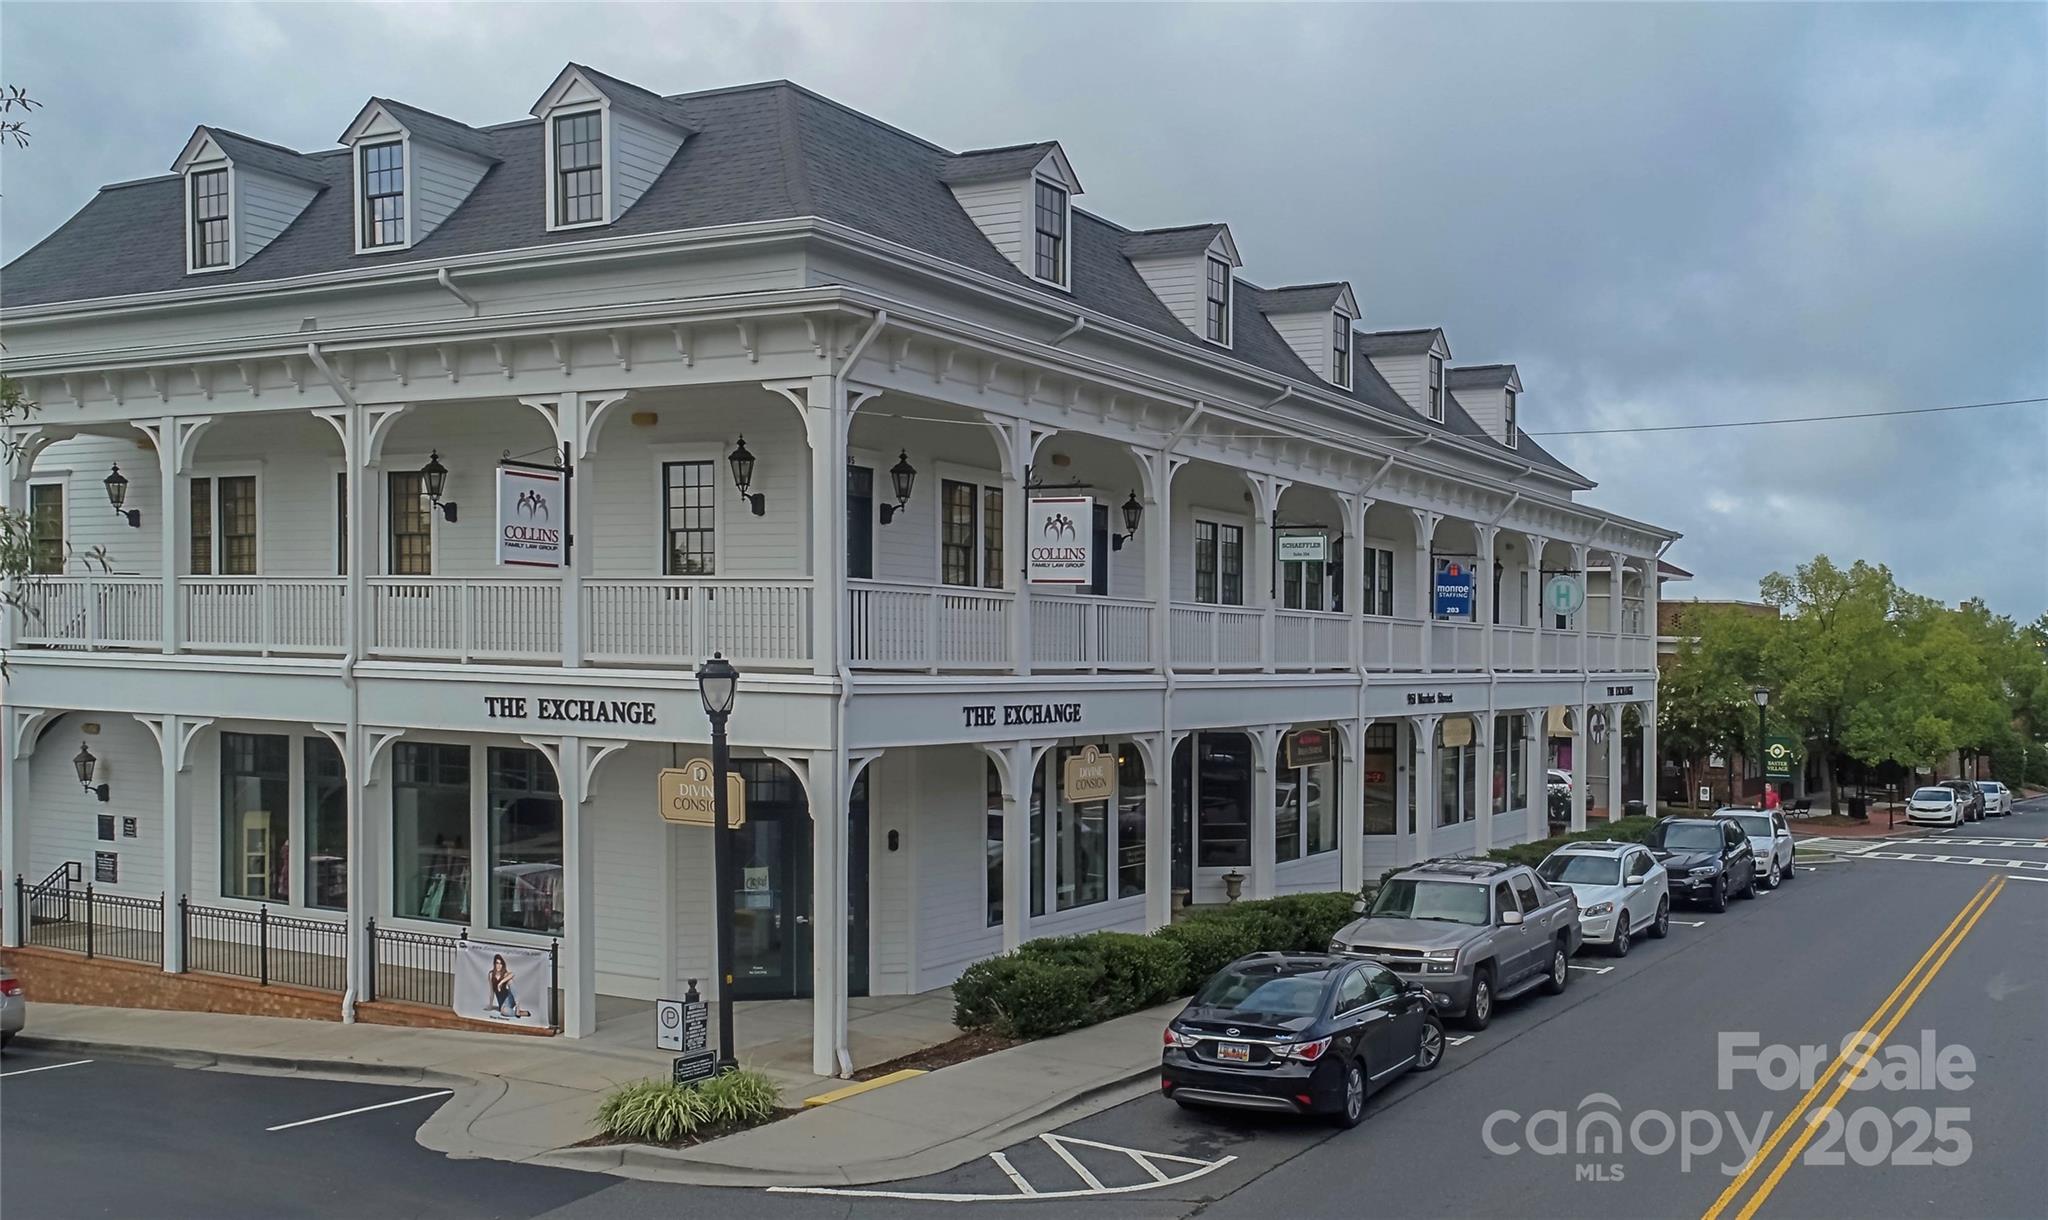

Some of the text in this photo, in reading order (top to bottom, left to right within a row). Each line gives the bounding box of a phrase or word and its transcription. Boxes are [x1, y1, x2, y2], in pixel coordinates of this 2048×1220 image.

[504, 525, 559, 543] COLLINS
[1031, 547, 1086, 560] COLLINS
[1437, 585, 1469, 593] monroe
[1556, 585, 1571, 607] H
[484, 696, 657, 725] THE EXCHANGE
[962, 703, 1082, 727] THE EXCHANGE
[680, 783, 714, 798] DIVIN
